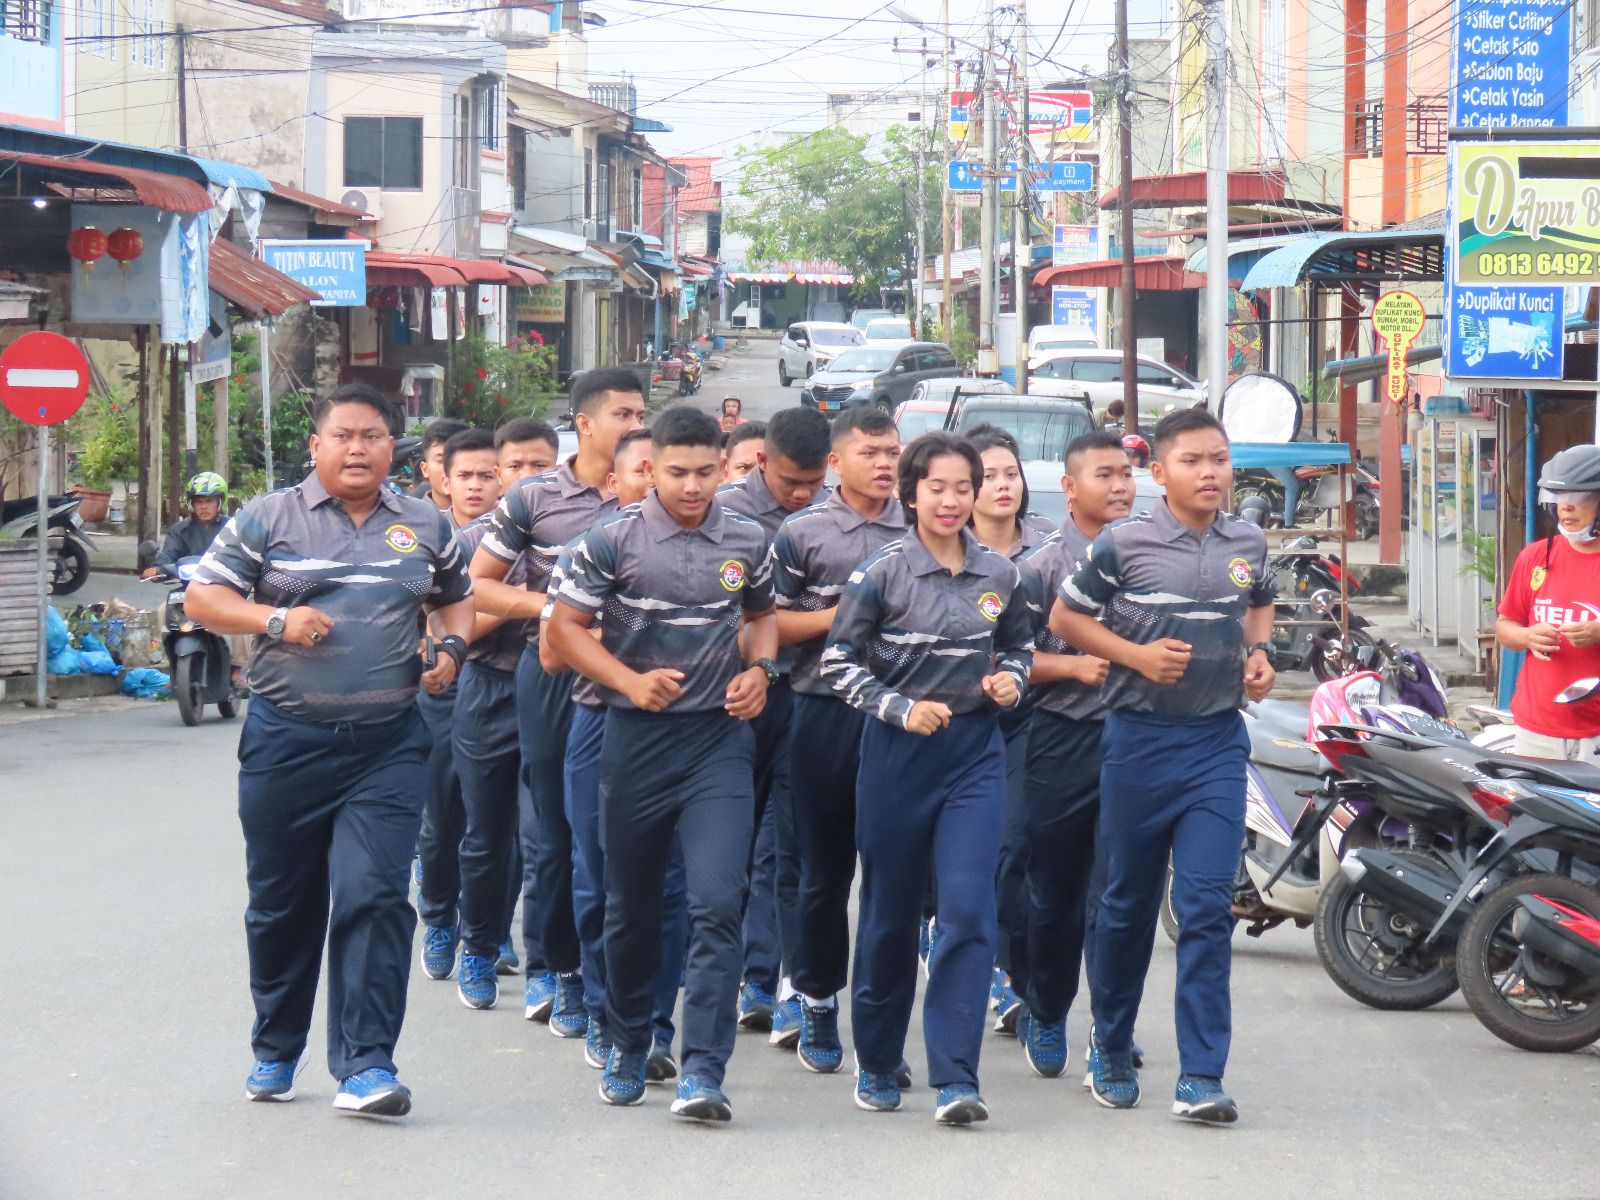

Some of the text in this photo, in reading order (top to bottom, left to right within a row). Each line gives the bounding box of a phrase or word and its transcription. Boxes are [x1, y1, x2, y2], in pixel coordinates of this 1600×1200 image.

[1471, 10, 1553, 35] Stiker Cutting
[1471, 35, 1539, 56] Cetak Foto
[1471, 61, 1544, 86] Sablon Baju
[1470, 87, 1544, 107] Cetak Yasin
[1053, 178, 1085, 187] payment
[273, 251, 355, 274] TITIN BEAUTY
[1478, 252, 1533, 276] 0813
[1536, 252, 1594, 276] 6492
[1464, 292, 1554, 314] Duplikat Kunci
